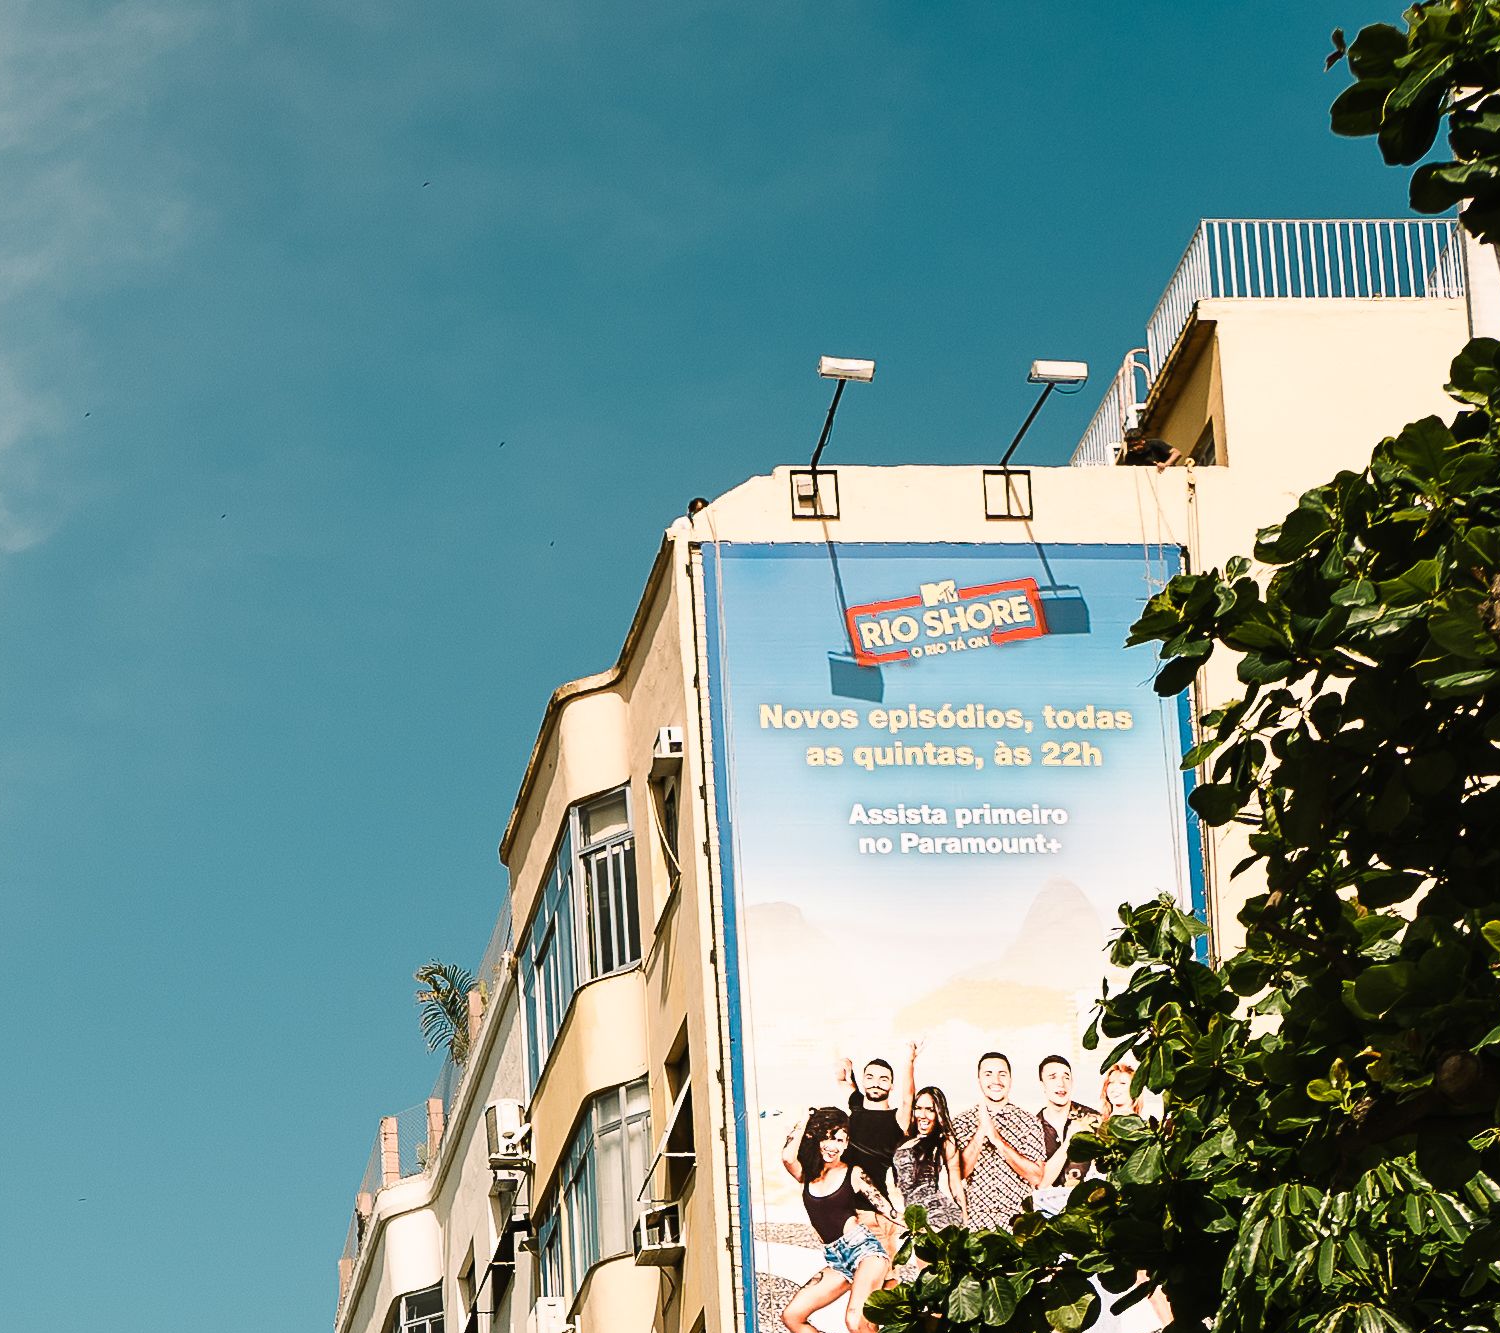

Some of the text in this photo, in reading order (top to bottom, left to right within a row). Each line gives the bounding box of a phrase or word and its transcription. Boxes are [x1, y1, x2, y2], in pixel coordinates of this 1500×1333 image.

[858, 595, 1032, 649] RIO SHORE
[911, 646, 924, 658] O
[924, 642, 948, 655] RIO
[967, 635, 990, 648] ON
[759, 703, 1134, 734] Novos episódios, todas
[806, 741, 1103, 771] as quintas, às 22h
[848, 803, 1069, 829] Assista primeiro
[858, 833, 1062, 854] no Paramount+
